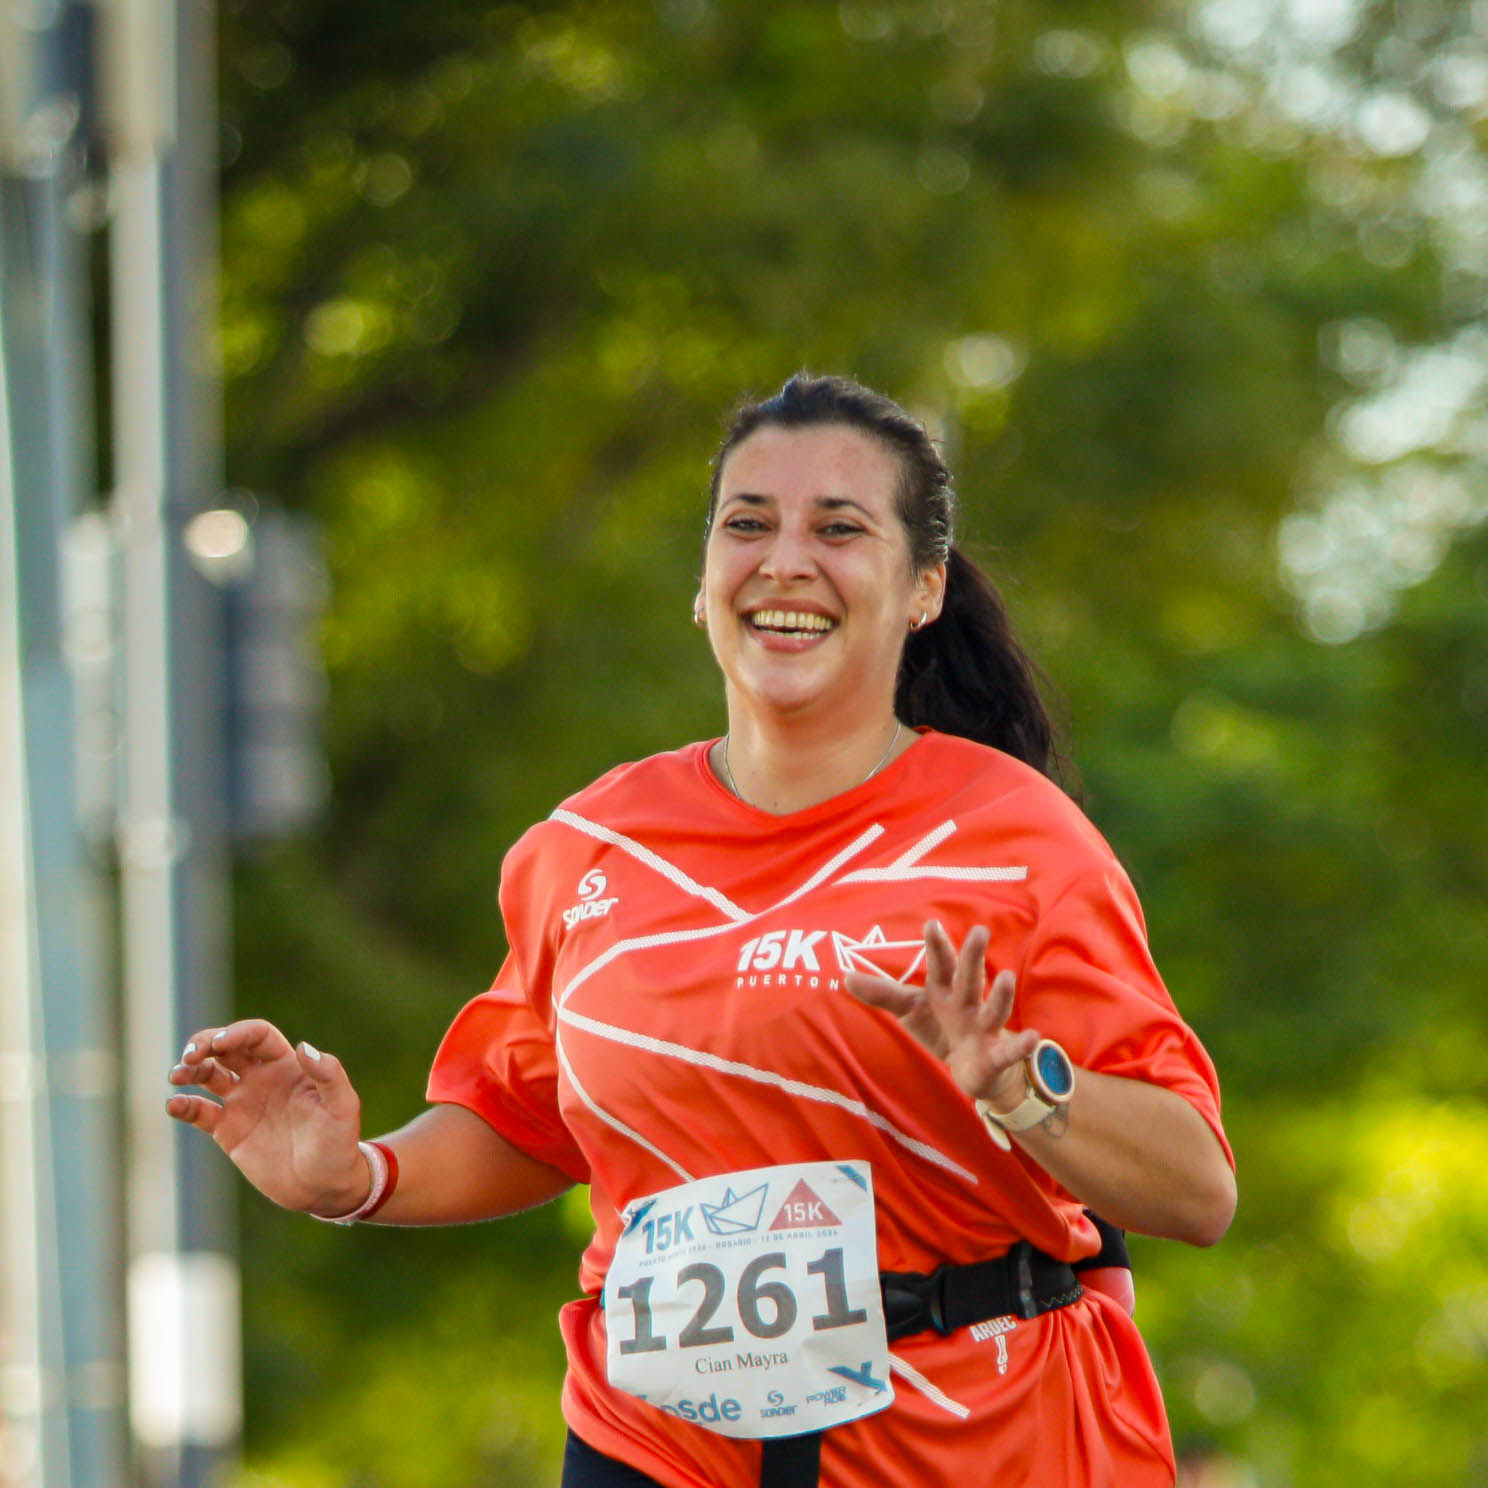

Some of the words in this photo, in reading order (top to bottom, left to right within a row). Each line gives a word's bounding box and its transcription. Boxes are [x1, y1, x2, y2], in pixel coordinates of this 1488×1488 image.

[737, 929, 828, 972] 15K
[736, 973, 820, 989] PUERTO
[783, 1200, 824, 1223] 15K
[641, 1205, 696, 1255] 15K
[616, 1247, 868, 1356] 1261
[694, 1357, 733, 1376] Cian
[736, 1351, 790, 1374] Mayra
